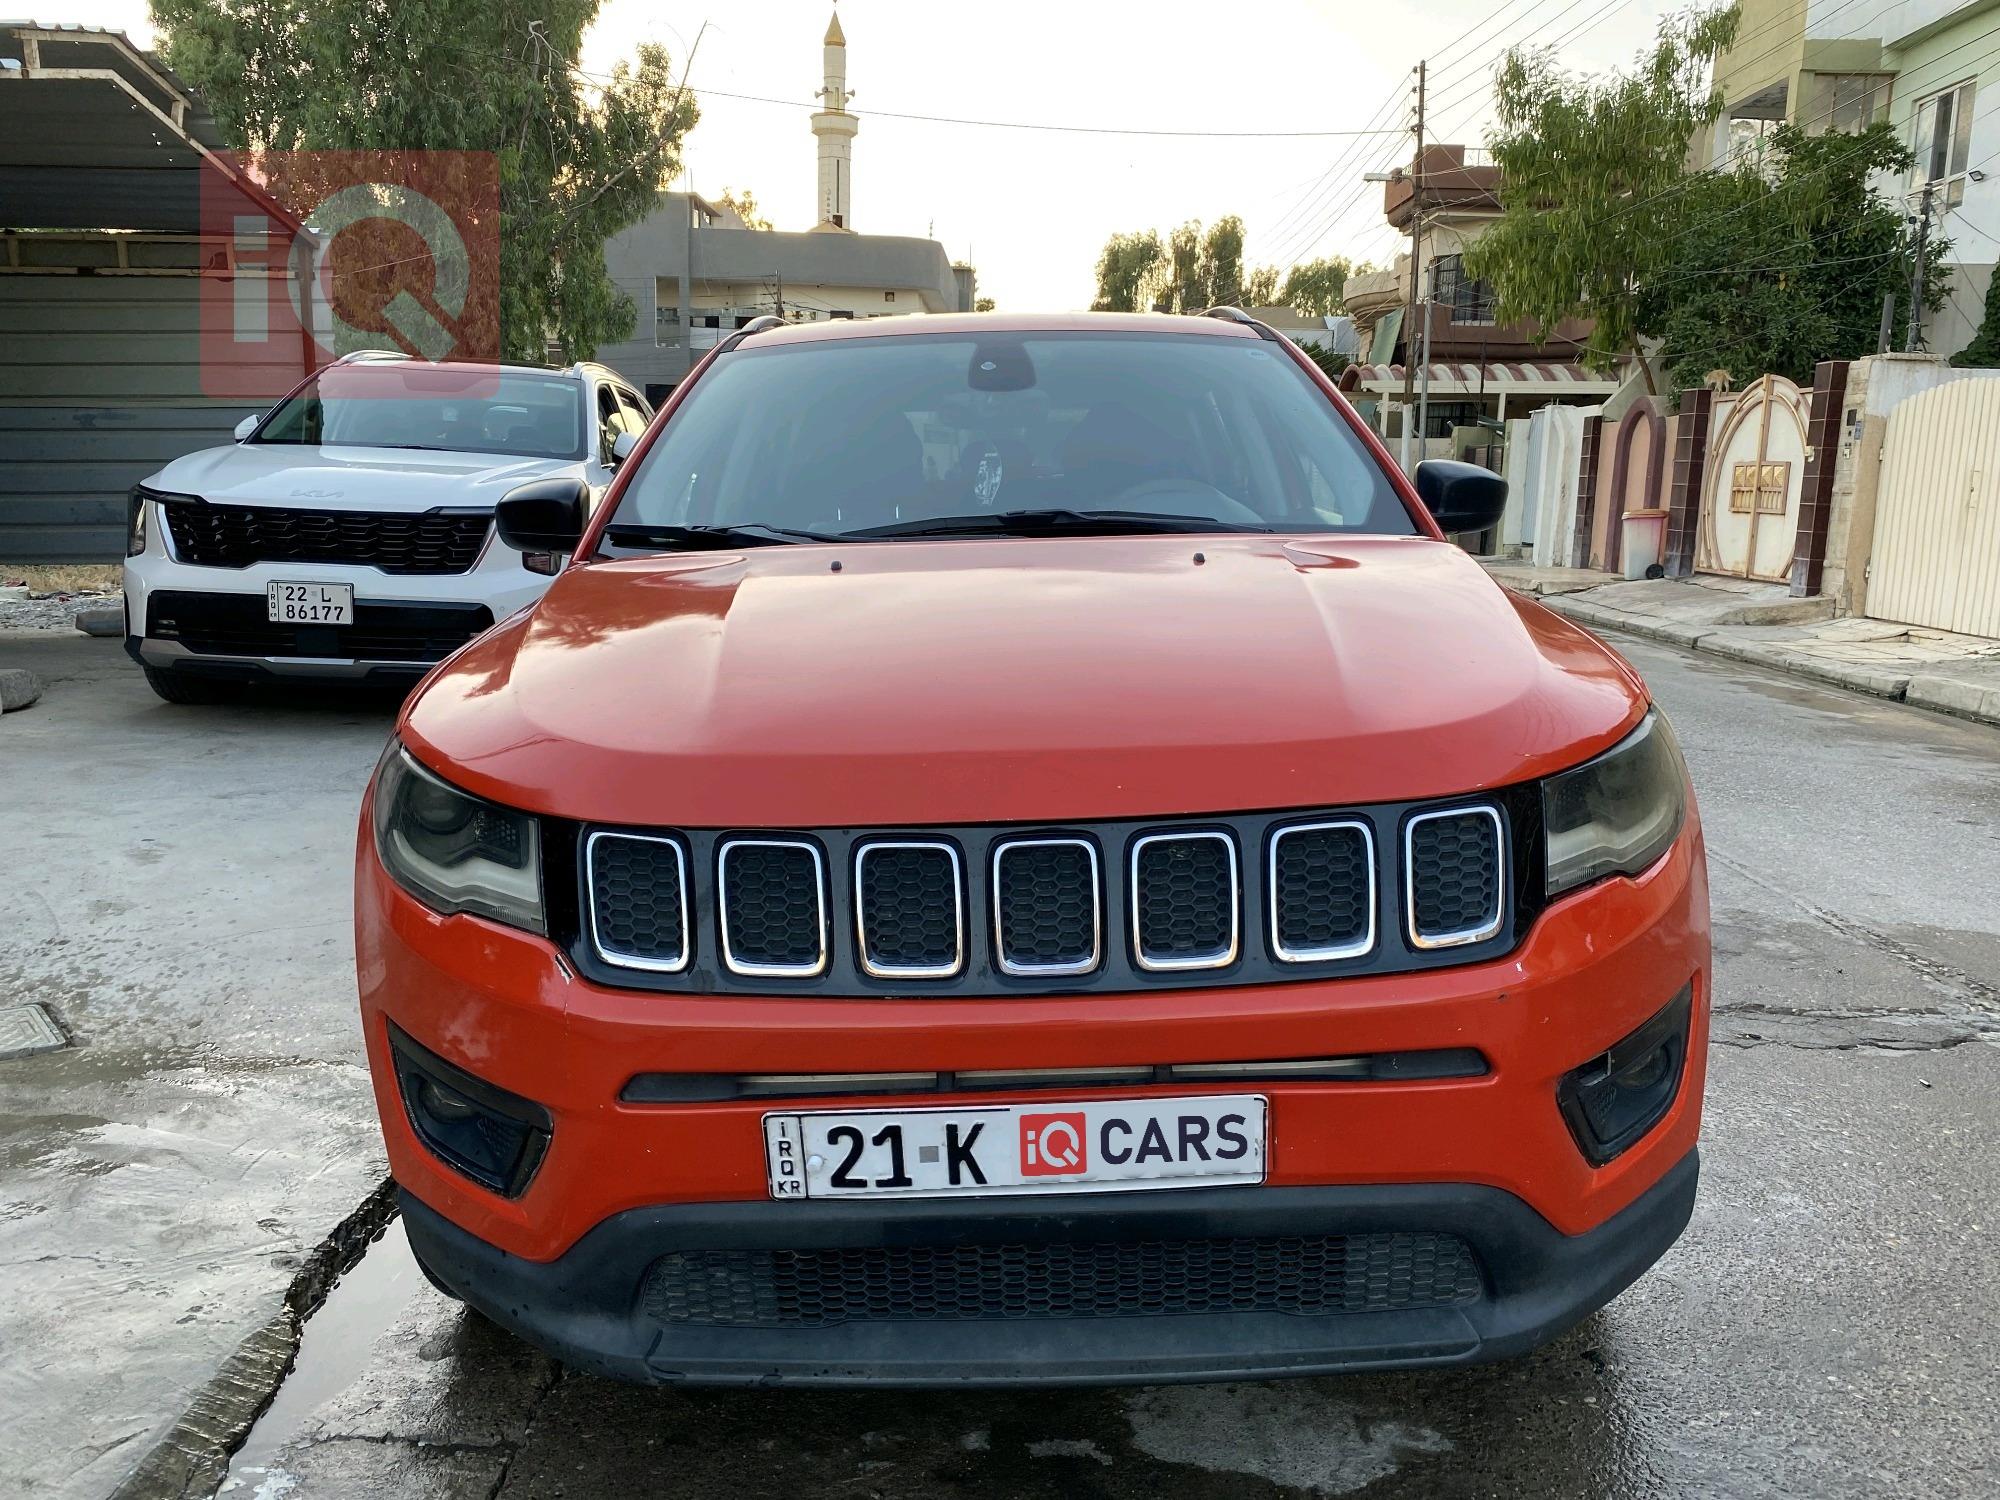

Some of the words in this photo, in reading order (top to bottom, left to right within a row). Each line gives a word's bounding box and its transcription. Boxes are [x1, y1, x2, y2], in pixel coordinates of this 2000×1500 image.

[285, 586, 307, 602] 22
[321, 588, 331, 602] L
[286, 604, 344, 621] 86177
[827, 1125, 912, 1188] 21
[945, 1122, 988, 1185] K
[777, 1181, 800, 1193] KR
